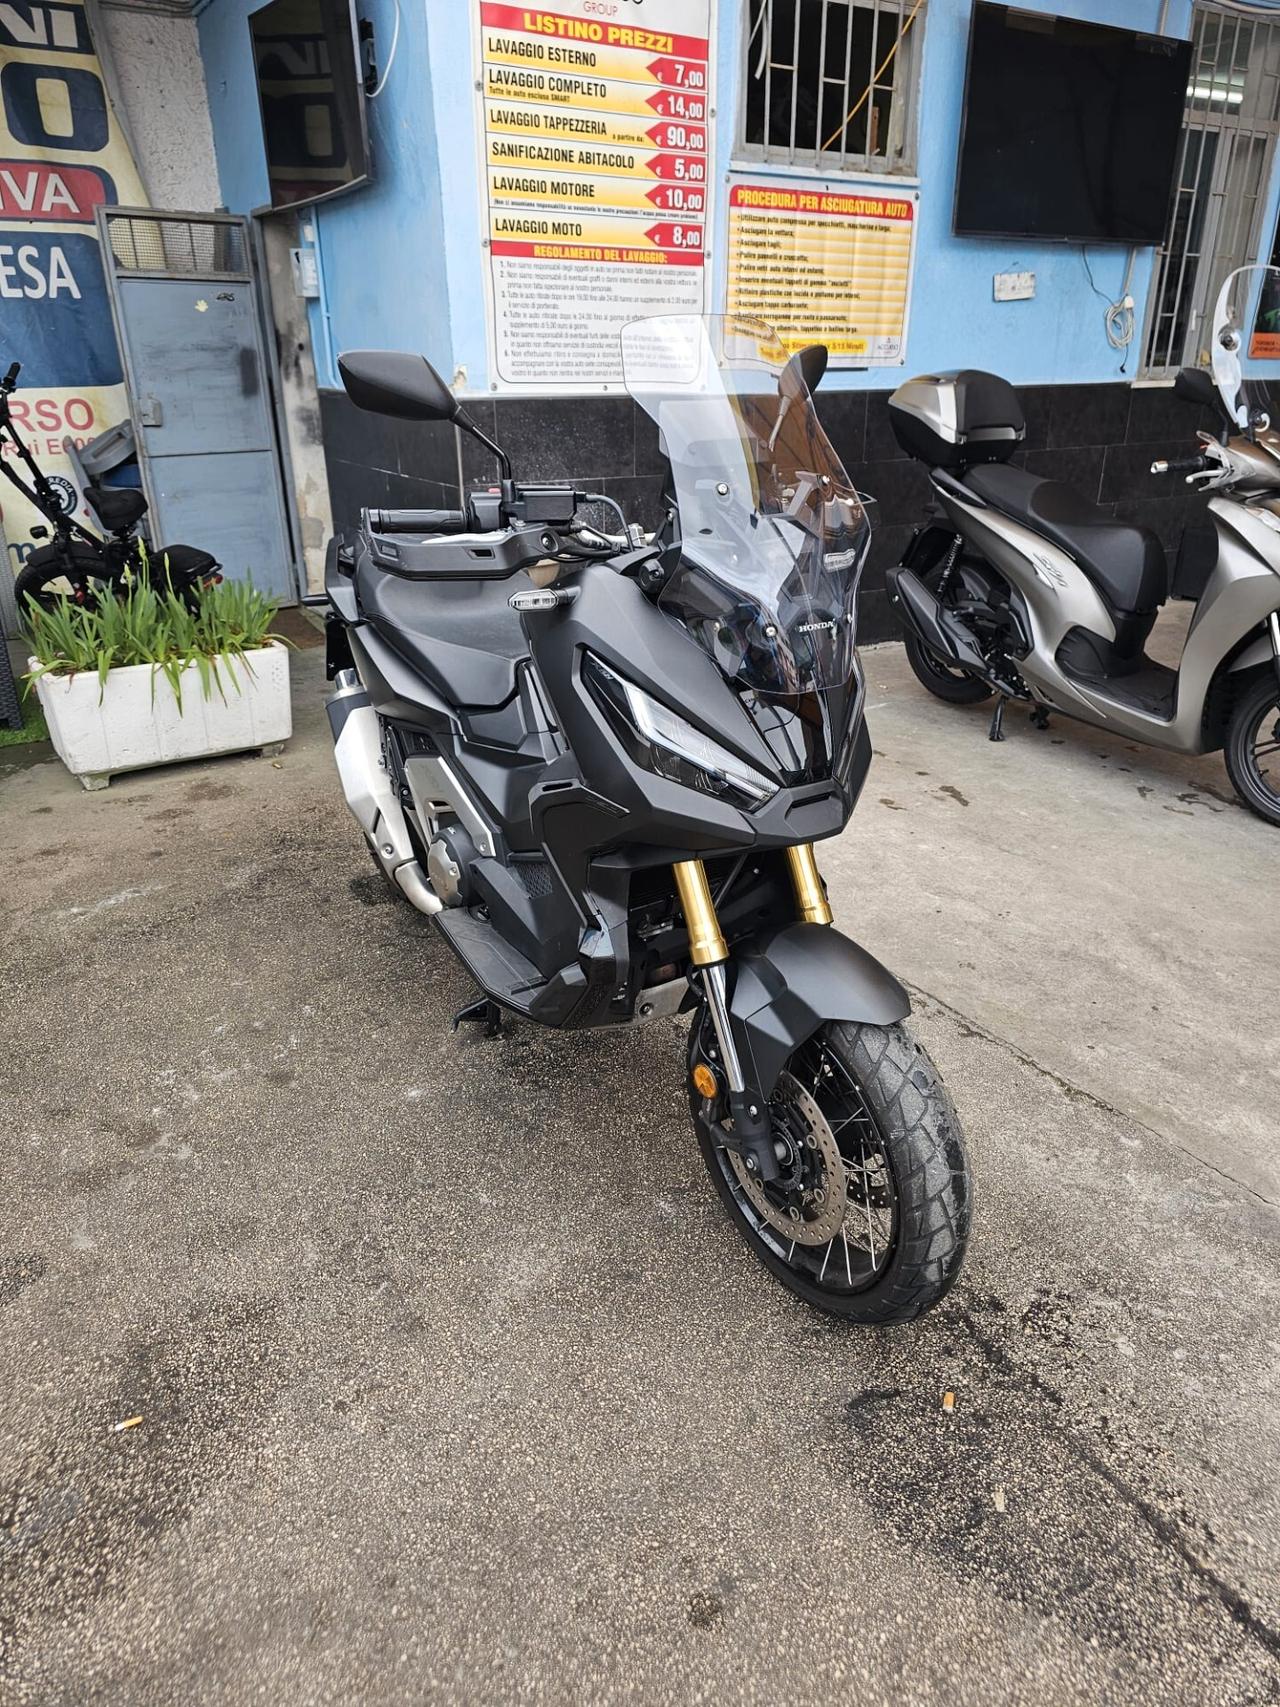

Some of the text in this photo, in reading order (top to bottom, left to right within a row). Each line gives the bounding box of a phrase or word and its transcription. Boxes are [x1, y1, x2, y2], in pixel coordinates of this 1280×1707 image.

[584, 1, 618, 16] GROUP
[523, 13, 673, 53] LISTINO PREZZI
[489, 37, 596, 67] LAVAGGIO ESTERNO
[489, 69, 606, 98] LAVAGGIO COMPLETO
[674, 64, 703, 88] 7,00
[668, 95, 703, 119] 14,00
[491, 109, 540, 128] LAVAGGIO
[544, 114, 607, 135] TAPPEZZERIA
[667, 126, 703, 150] 90,00
[492, 142, 634, 169] SANIFICAZIONE ABITACOLO
[674, 159, 703, 181] 5,00
[0, 171, 80, 213] VA
[494, 176, 595, 197] LAVAGGIO MOTORE
[666, 188, 702, 210] 10,00
[738, 190, 908, 217] PROCEDURA PER ASCIUGATURA AUTO
[495, 218, 582, 237] LAVAGGIO MOTO
[673, 227, 700, 248] 8,00
[534, 245, 668, 263] REGOLAMENTO DEL LAVAGGIO:
[798, 619, 836, 632] HONDA
